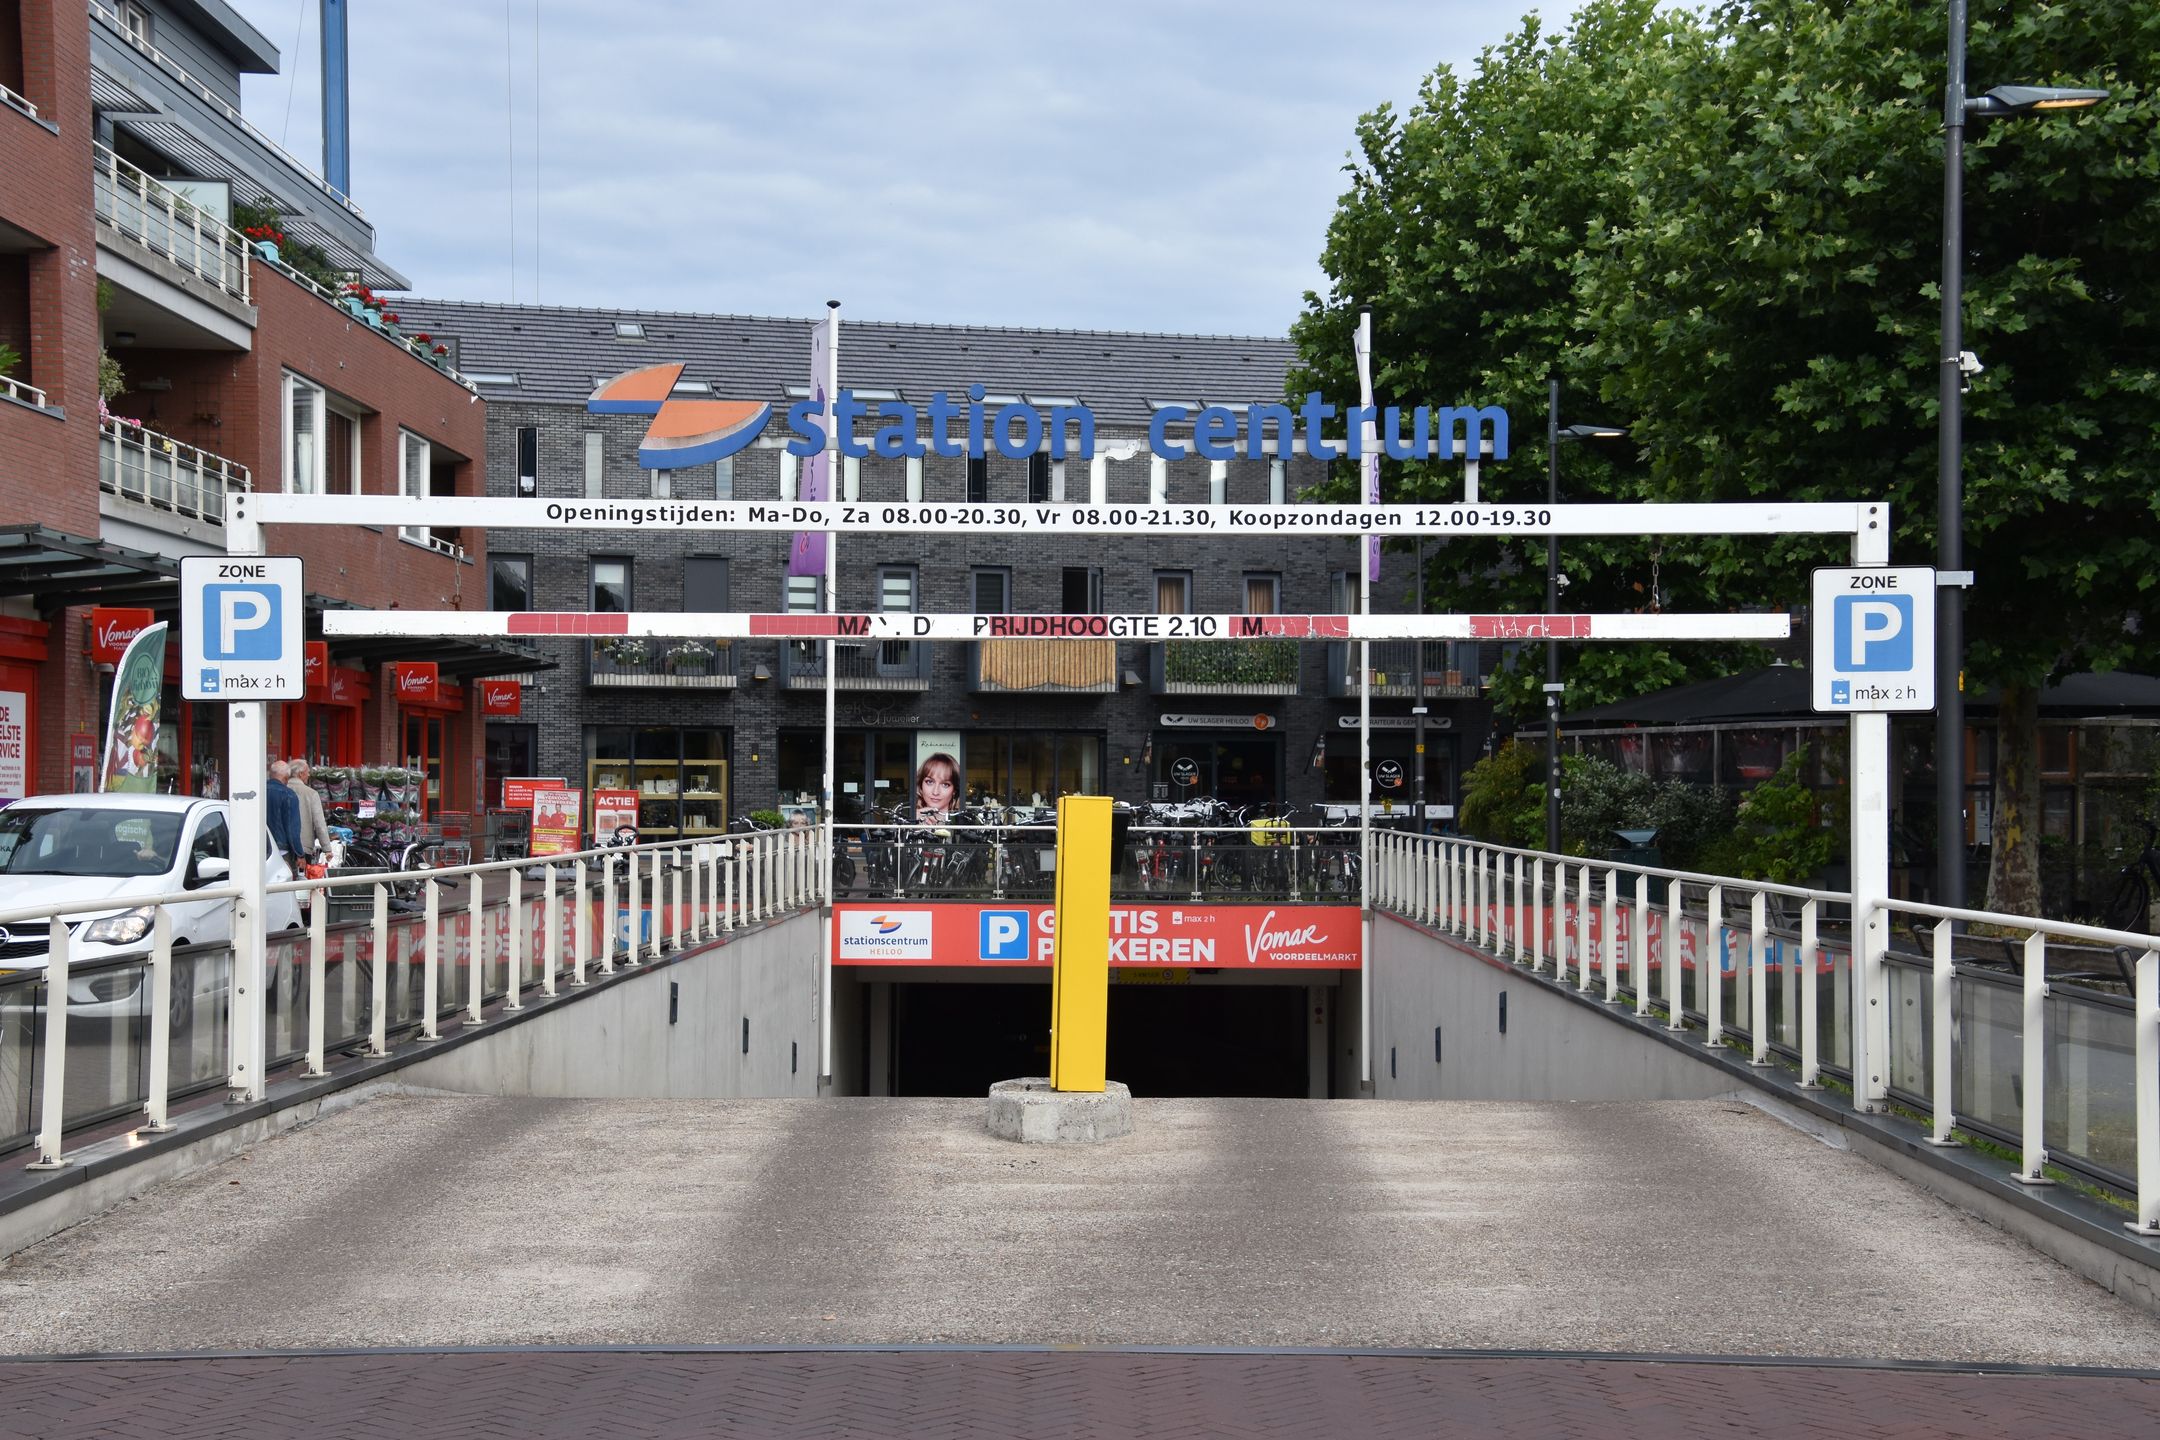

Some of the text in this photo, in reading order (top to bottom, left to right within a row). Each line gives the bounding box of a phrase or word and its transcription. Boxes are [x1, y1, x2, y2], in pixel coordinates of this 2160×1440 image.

[786, 383, 1509, 461] station centrum
[546, 503, 1552, 529] Openingstijden: Ma-Do, Za 08.00-20.30, Vr 08.00-21.30, Koopzondagen 12.00-19.30
[218, 565, 266, 578] ZONE
[1850, 576, 1898, 589] ZONE
[220, 591, 272, 654] P
[1168, 616, 1217, 637] 2.10
[1851, 602, 1903, 665] P
[225, 675, 285, 688] max 2 h
[1855, 686, 1916, 700] max 2 h
[1199, 717, 1225, 725] SLAGER
[598, 796, 635, 806] ACTIE!
[1184, 915, 1202, 923] max
[1209, 914, 1216, 923] h
[843, 935, 929, 946] stationscentrum
[988, 915, 1020, 955] P
[869, 948, 903, 956] HEILOO
[1269, 952, 1358, 961] VOORDEELMARKT
